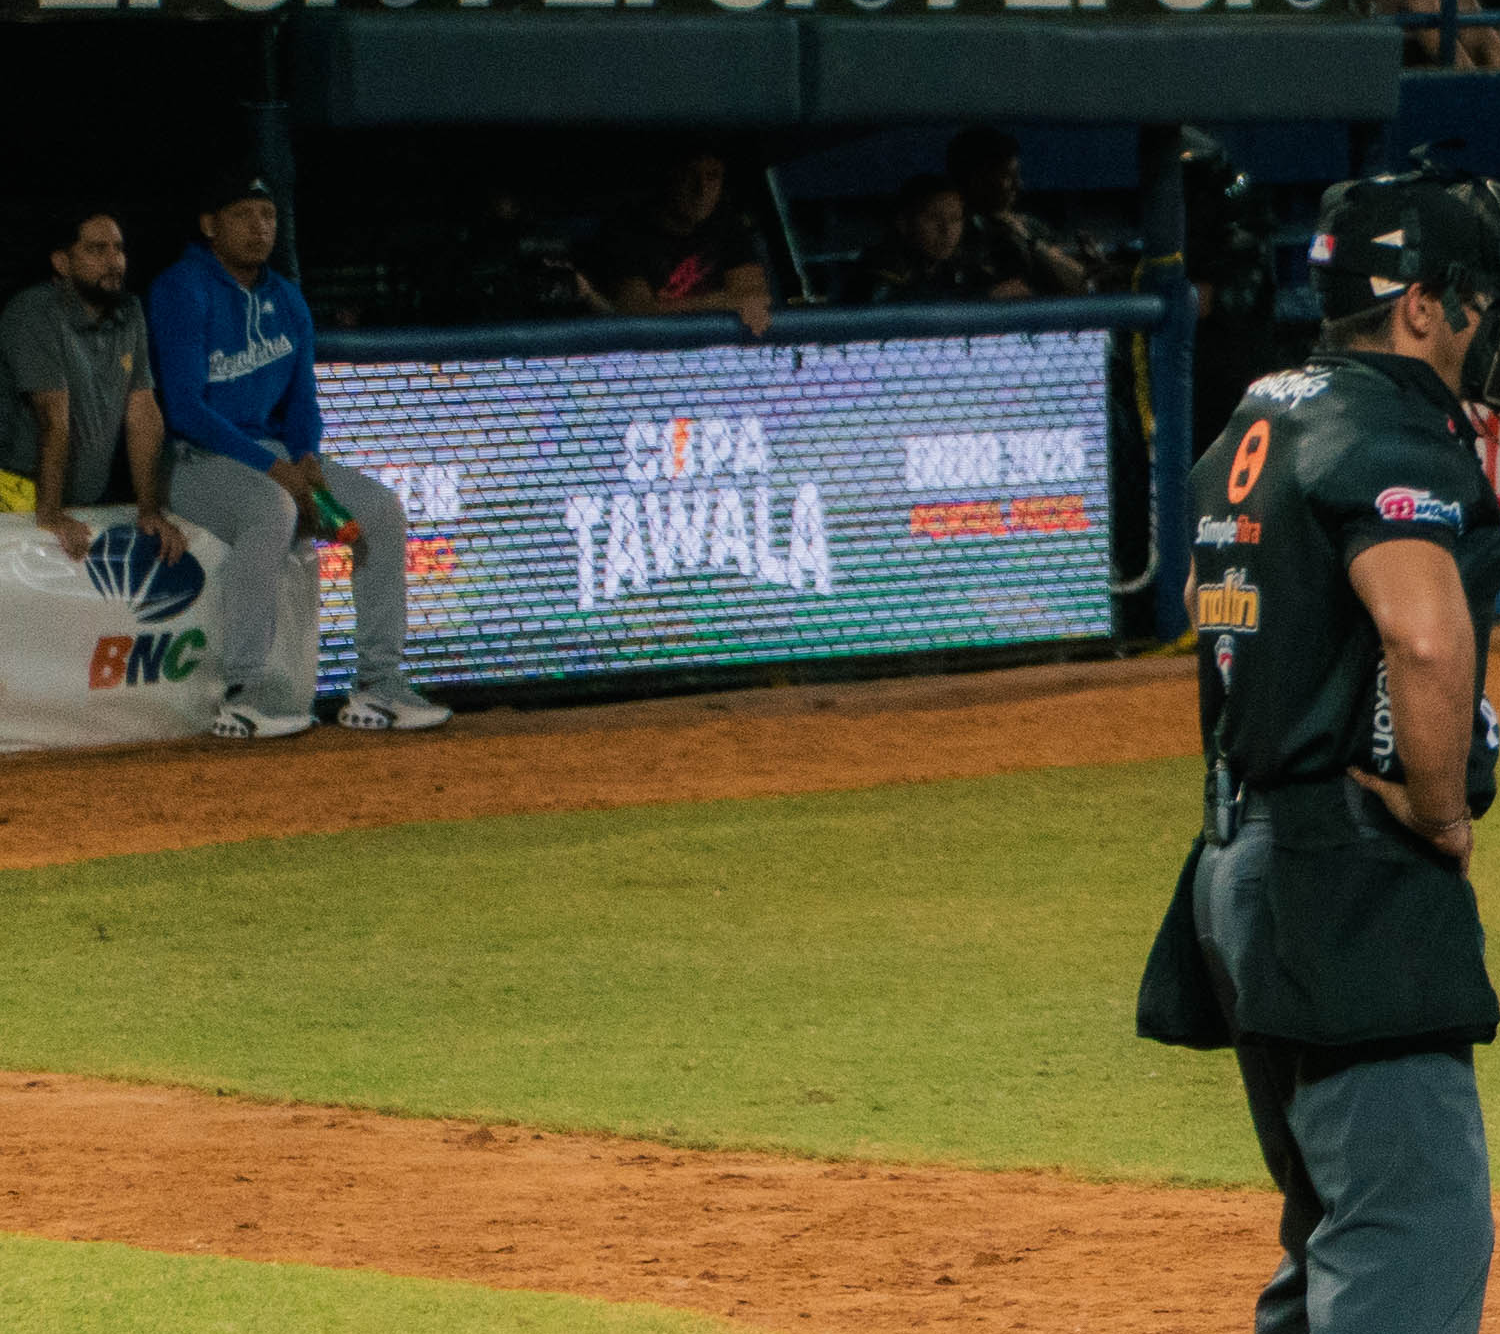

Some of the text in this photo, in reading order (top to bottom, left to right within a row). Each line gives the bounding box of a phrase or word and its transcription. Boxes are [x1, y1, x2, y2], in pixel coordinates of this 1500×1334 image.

[1227, 419, 1271, 505] 8
[566, 482, 832, 612] TAWALA
[88, 627, 207, 691] BNC
